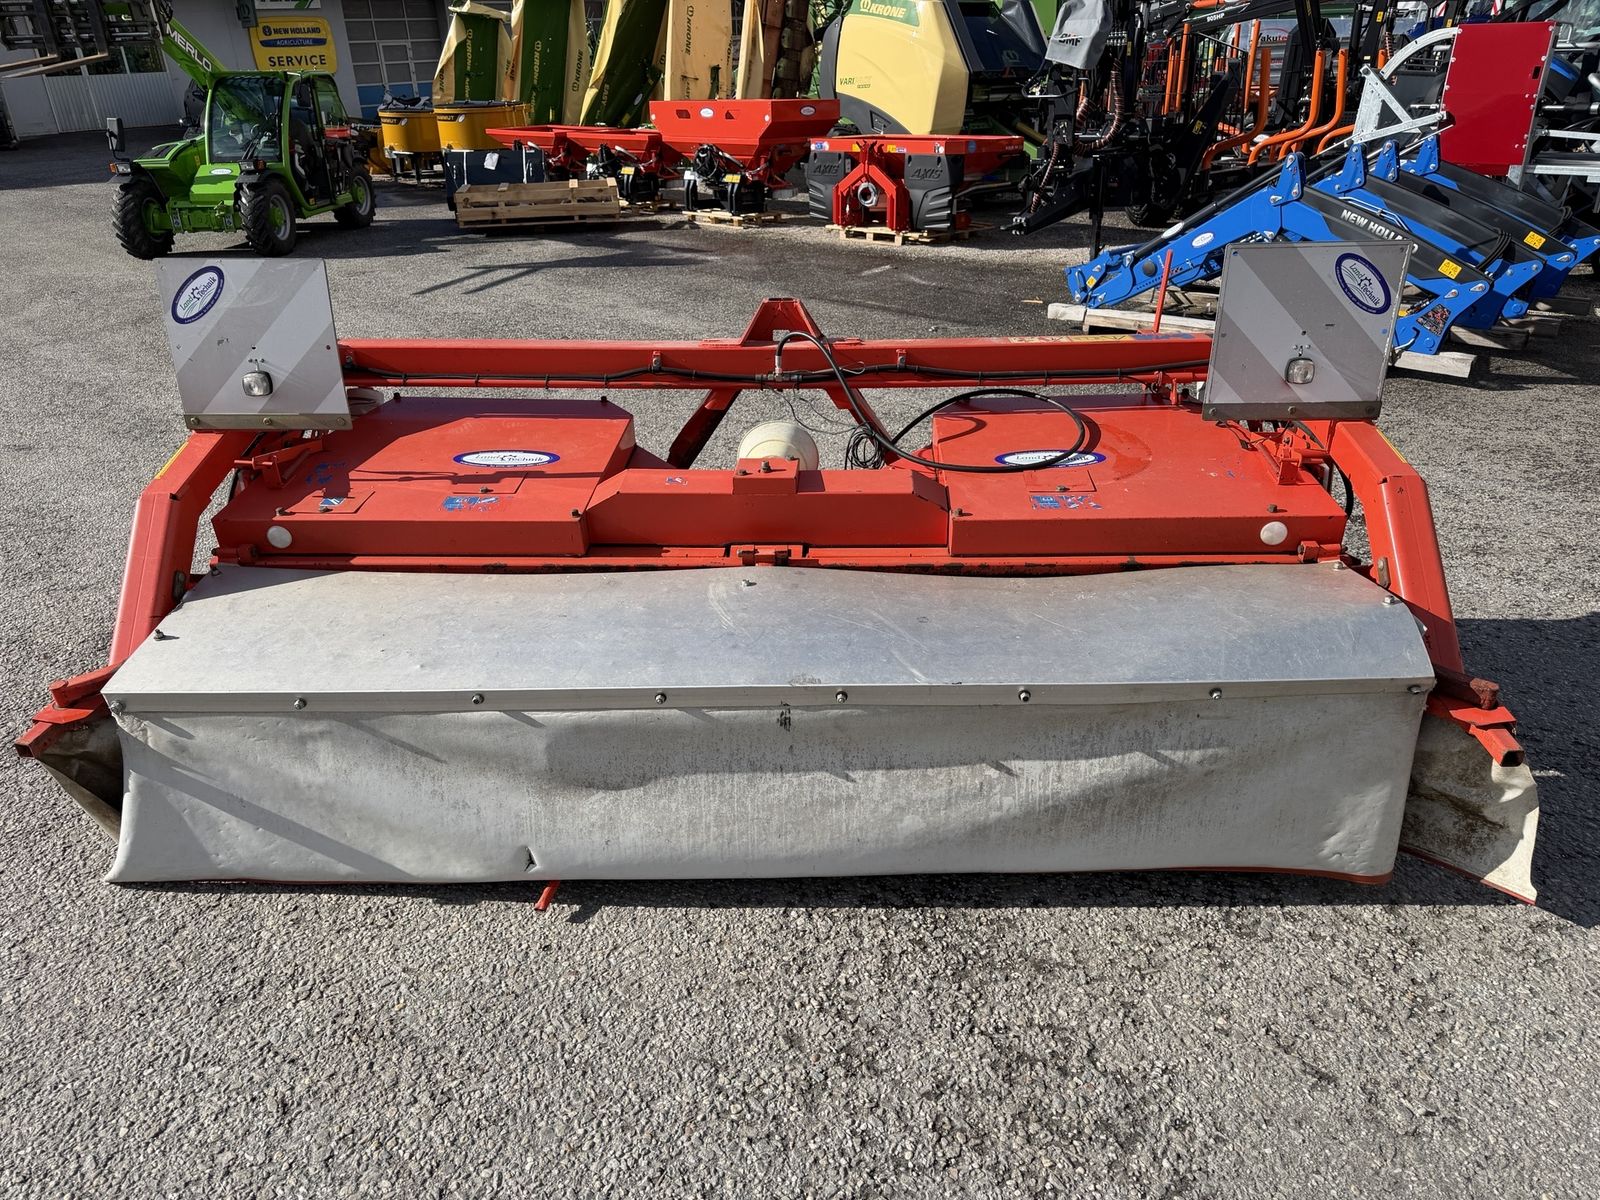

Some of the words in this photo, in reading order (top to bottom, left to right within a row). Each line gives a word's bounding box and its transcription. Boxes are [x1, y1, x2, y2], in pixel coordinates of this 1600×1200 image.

[870, 3, 907, 19] KRONE
[1206, 13, 1225, 22] 905HP
[289, 27, 321, 35] HOLLAND
[685, 17, 694, 56] KRONE
[1258, 32, 1289, 43] akute
[166, 24, 212, 72] MERLO
[276, 38, 314, 46] AGRICULTURE
[268, 54, 327, 67] SERVICE
[465, 39, 473, 71] KRONE
[533, 52, 541, 85] KRONE
[576, 49, 584, 81] KRONE
[839, 77, 855, 86] VARI
[601, 83, 610, 106] EASY
[814, 163, 840, 175] AXIS
[912, 167, 943, 180] AXIS
[1340, 209, 1368, 227] NEW
[1349, 262, 1366, 279] Land
[1360, 283, 1381, 306] Technik
[179, 294, 194, 311] Land
[196, 276, 217, 298] Technik
